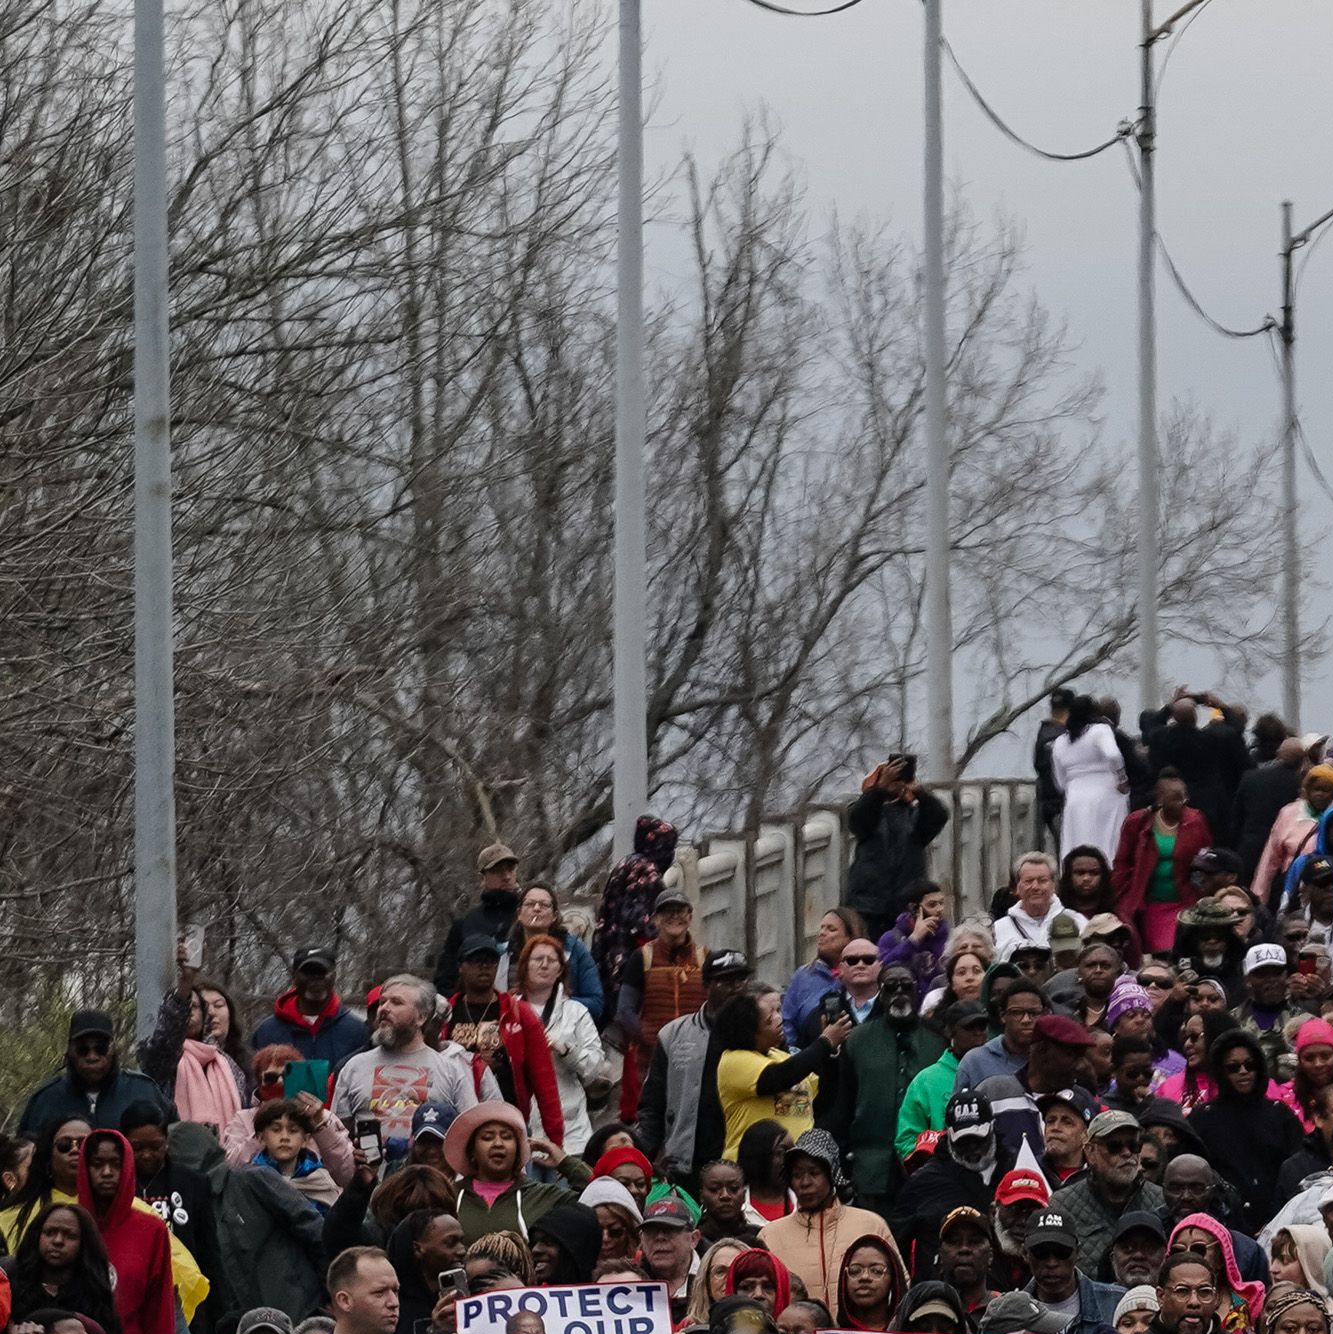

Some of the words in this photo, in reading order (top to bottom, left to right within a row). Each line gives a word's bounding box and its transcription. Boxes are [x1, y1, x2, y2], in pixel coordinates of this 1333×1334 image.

[1047, 1213, 1062, 1221] AM
[1045, 1219, 1063, 1227] MAN
[463, 1283, 657, 1329] PROTECT
